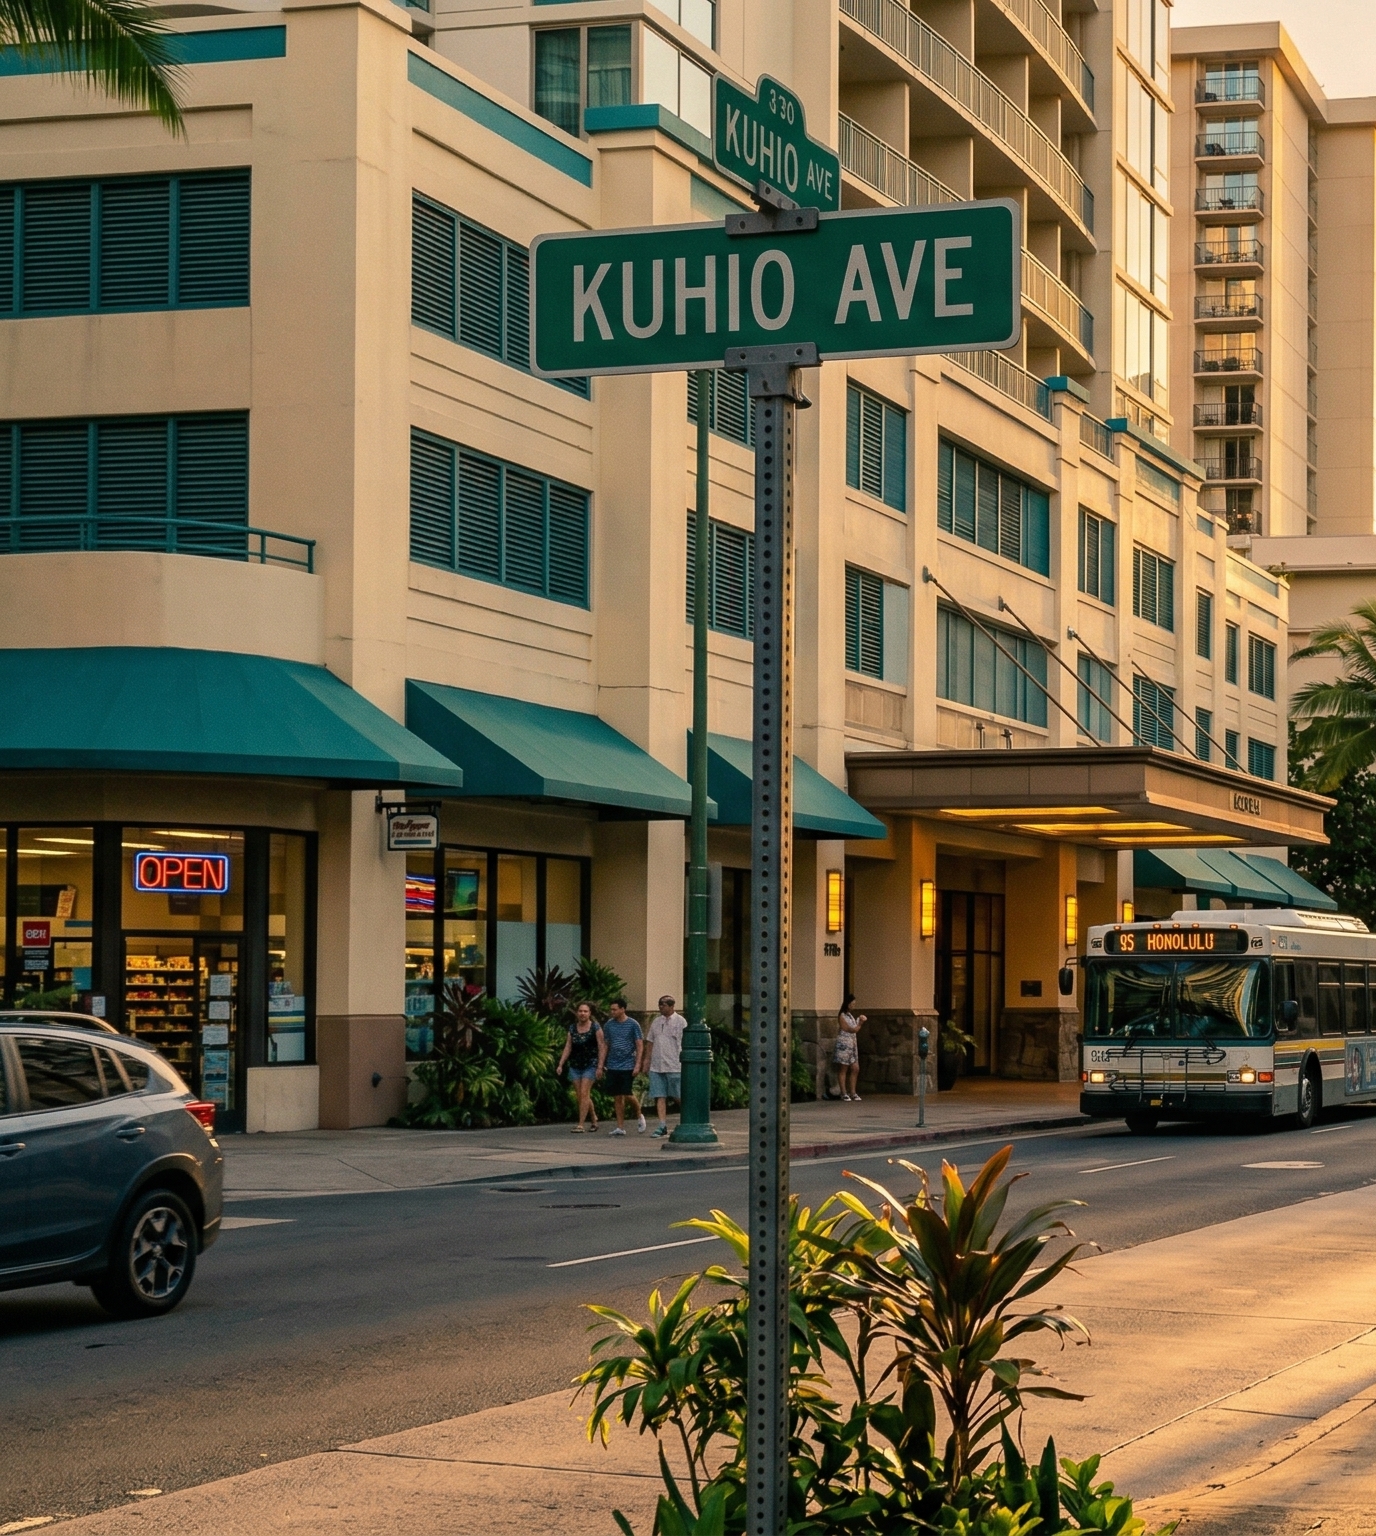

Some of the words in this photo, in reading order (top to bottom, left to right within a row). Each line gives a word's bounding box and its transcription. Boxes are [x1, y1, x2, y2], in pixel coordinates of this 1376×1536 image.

[768, 88, 796, 127] 330
[726, 104, 798, 194] KUHIO
[806, 158, 833, 202] AVE
[573, 249, 796, 343] KUHIO
[834, 236, 974, 325] AVE
[139, 856, 224, 890] OPEN
[1147, 933, 1214, 951] HONOLULU
